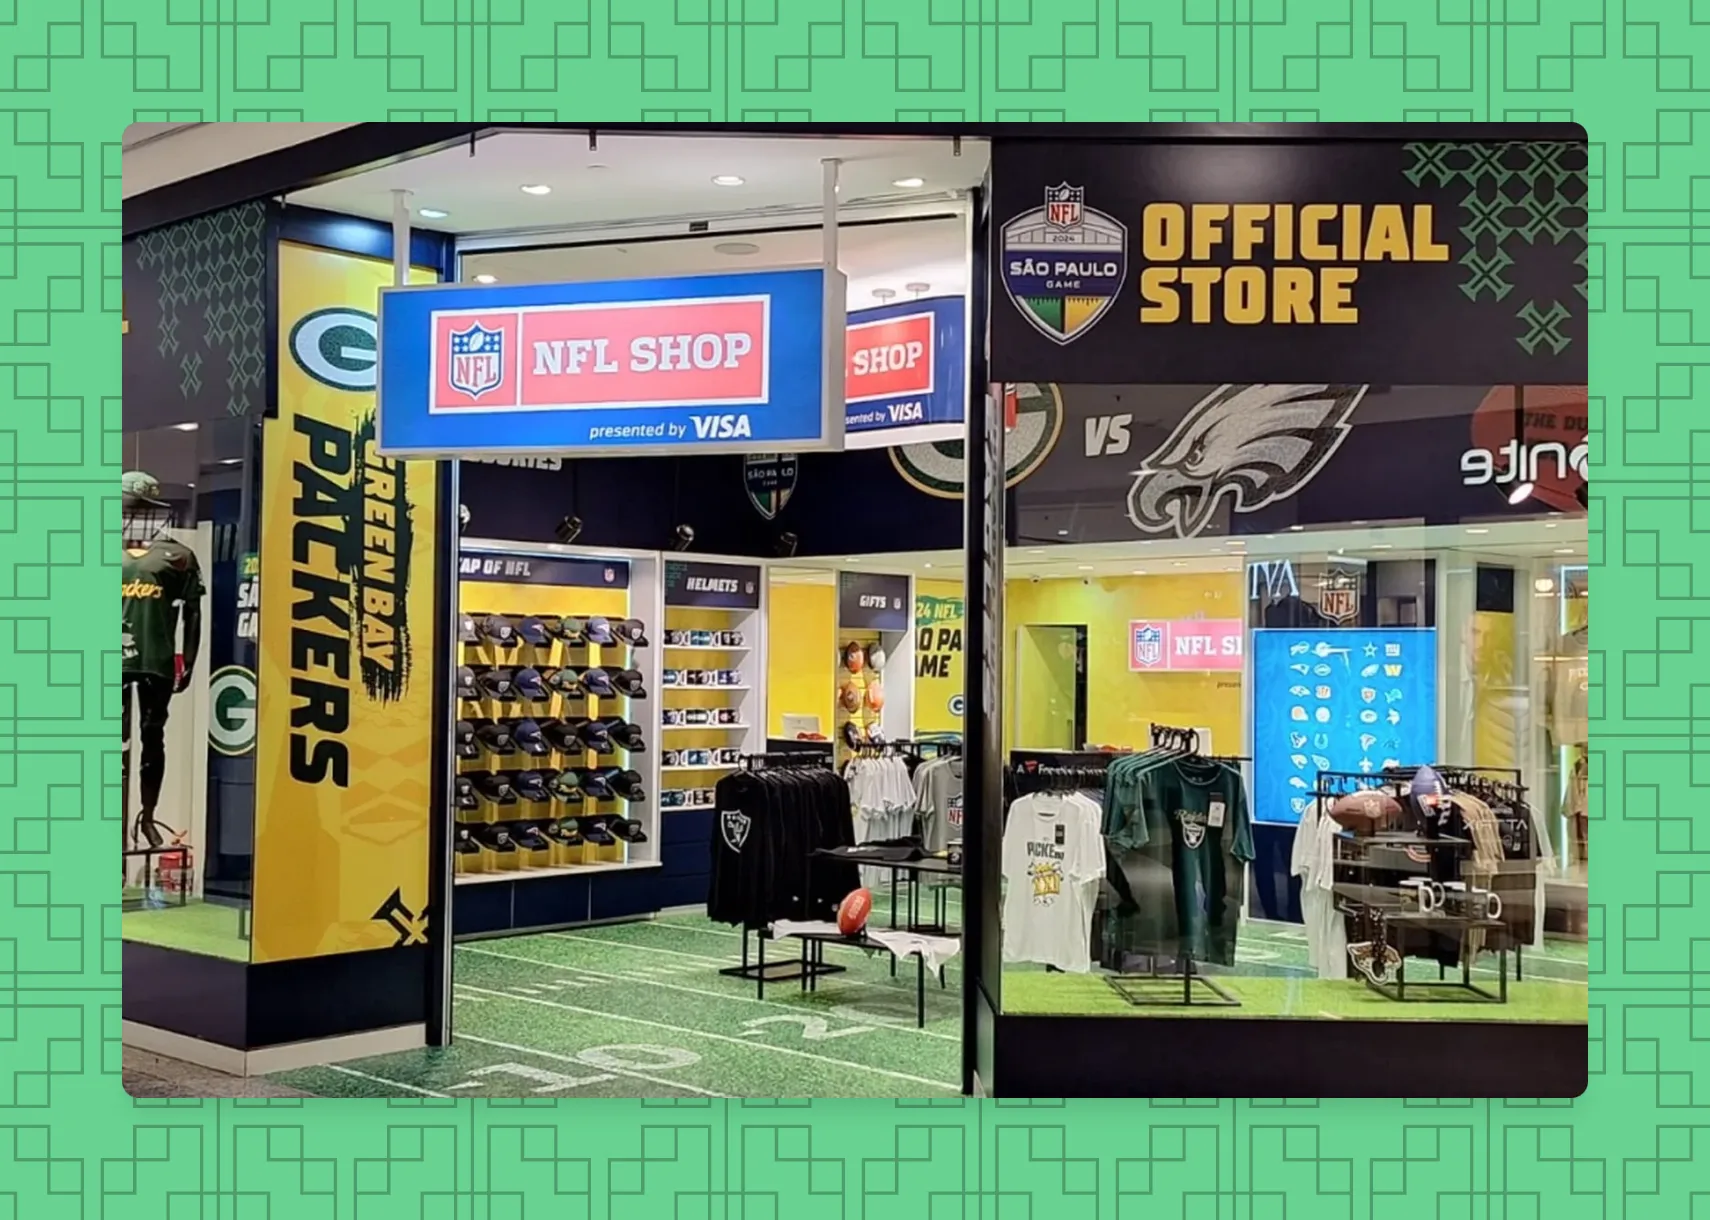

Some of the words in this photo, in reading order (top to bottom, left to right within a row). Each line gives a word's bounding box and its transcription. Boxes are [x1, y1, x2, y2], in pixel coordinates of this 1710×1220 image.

[1050, 204, 1079, 224] NFL
[1142, 203, 1449, 261] OFFICIAL
[1010, 258, 1049, 276] SÃO
[1055, 261, 1117, 276] PAULO
[1046, 280, 1080, 288] GAME
[1140, 266, 1358, 324] STORE
[532, 338, 618, 375] NFL
[630, 332, 752, 373] SHOP
[853, 341, 923, 376] SHOP
[456, 355, 496, 388] NFL
[875, 411, 886, 423] by
[887, 401, 923, 422] VISA
[589, 421, 665, 440] presented
[668, 423, 687, 440] by
[689, 415, 752, 439] VISA
[1085, 413, 1132, 457] VS
[459, 557, 481, 574] AP
[483, 560, 502, 575] OF
[504, 562, 531, 577] NFL
[686, 576, 739, 593] HELMETS
[289, 413, 351, 788] PACKERS
[859, 594, 887, 608] GIFTS
[1323, 592, 1354, 616] NFL
[363, 586, 396, 671] BAY
[915, 627, 933, 652] O
[1175, 635, 1217, 656] NFL
[915, 653, 952, 678] ME
